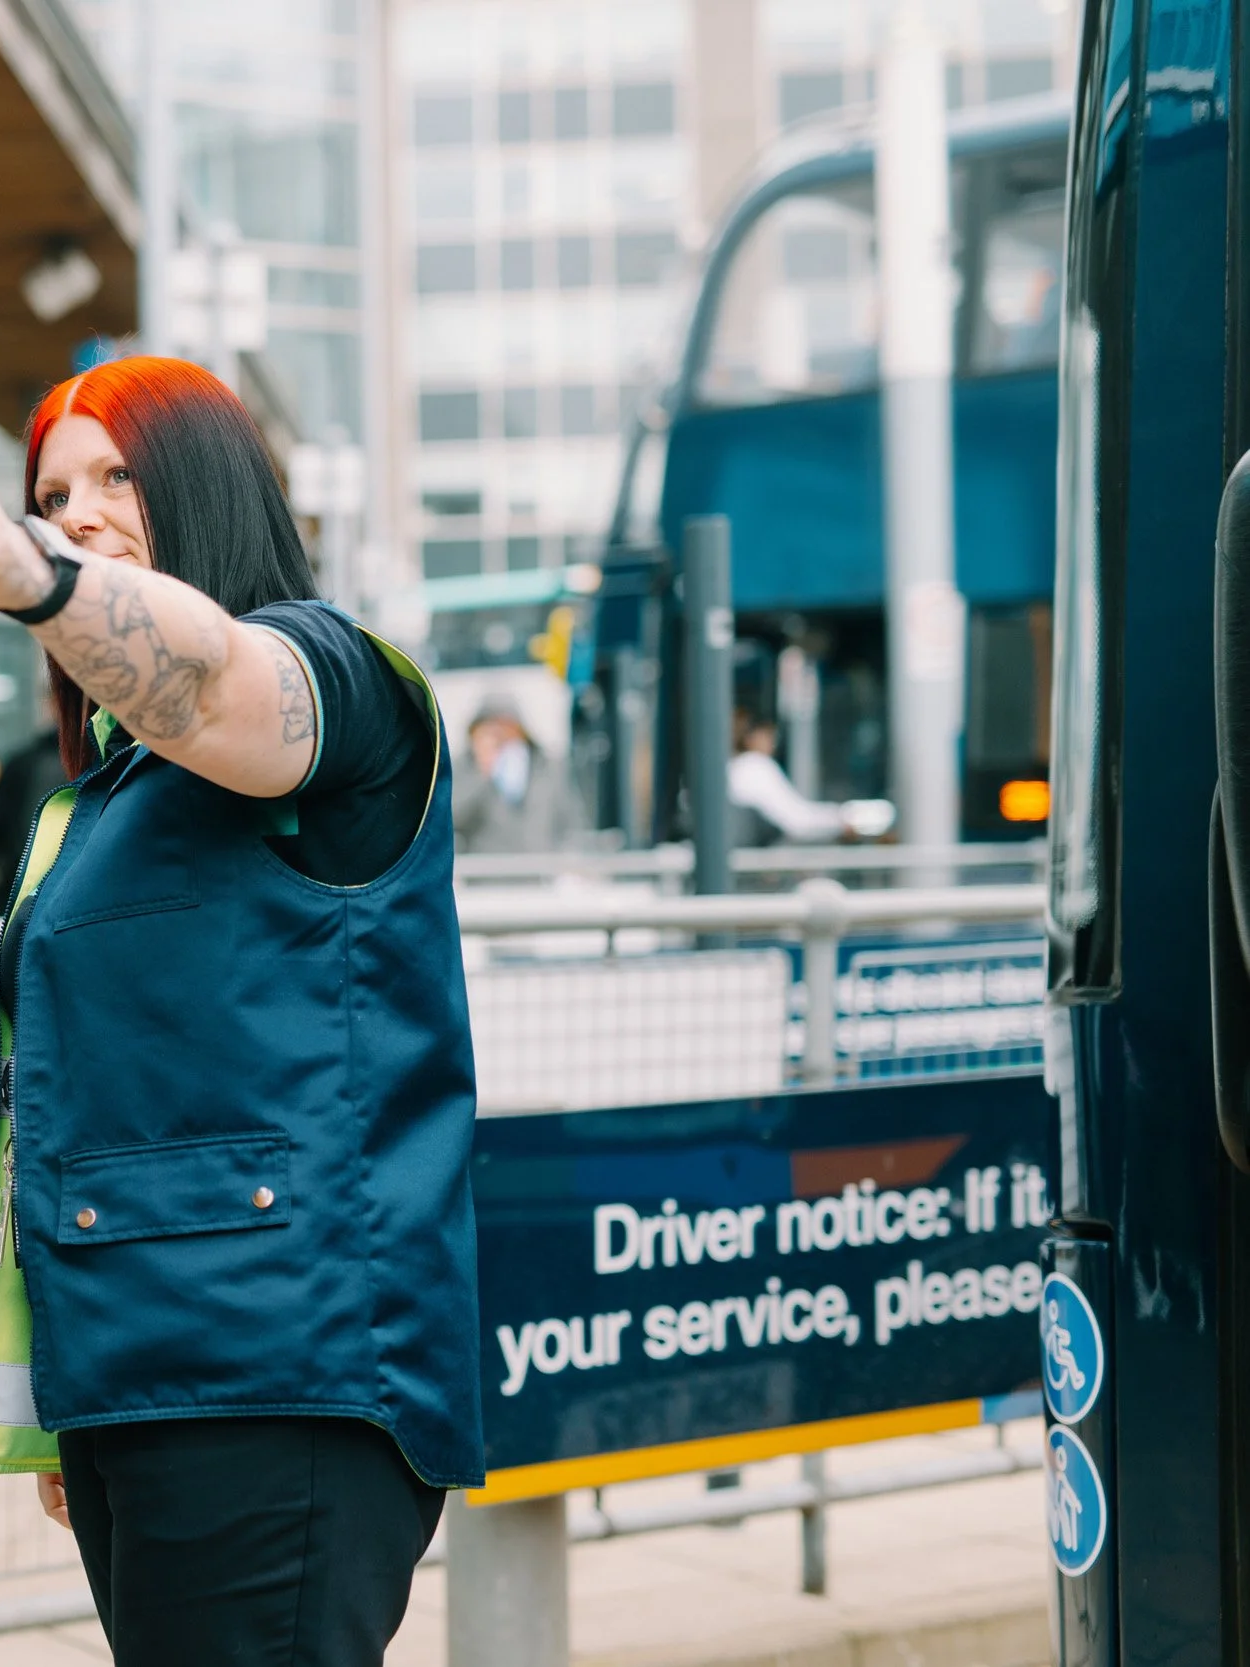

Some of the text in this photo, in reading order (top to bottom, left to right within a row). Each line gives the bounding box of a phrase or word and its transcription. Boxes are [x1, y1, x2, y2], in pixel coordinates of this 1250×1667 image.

[594, 1198, 765, 1274] Driver
[776, 1177, 950, 1254] notice:
[964, 1166, 1000, 1233] If
[496, 1259, 1042, 1396] your service, please
